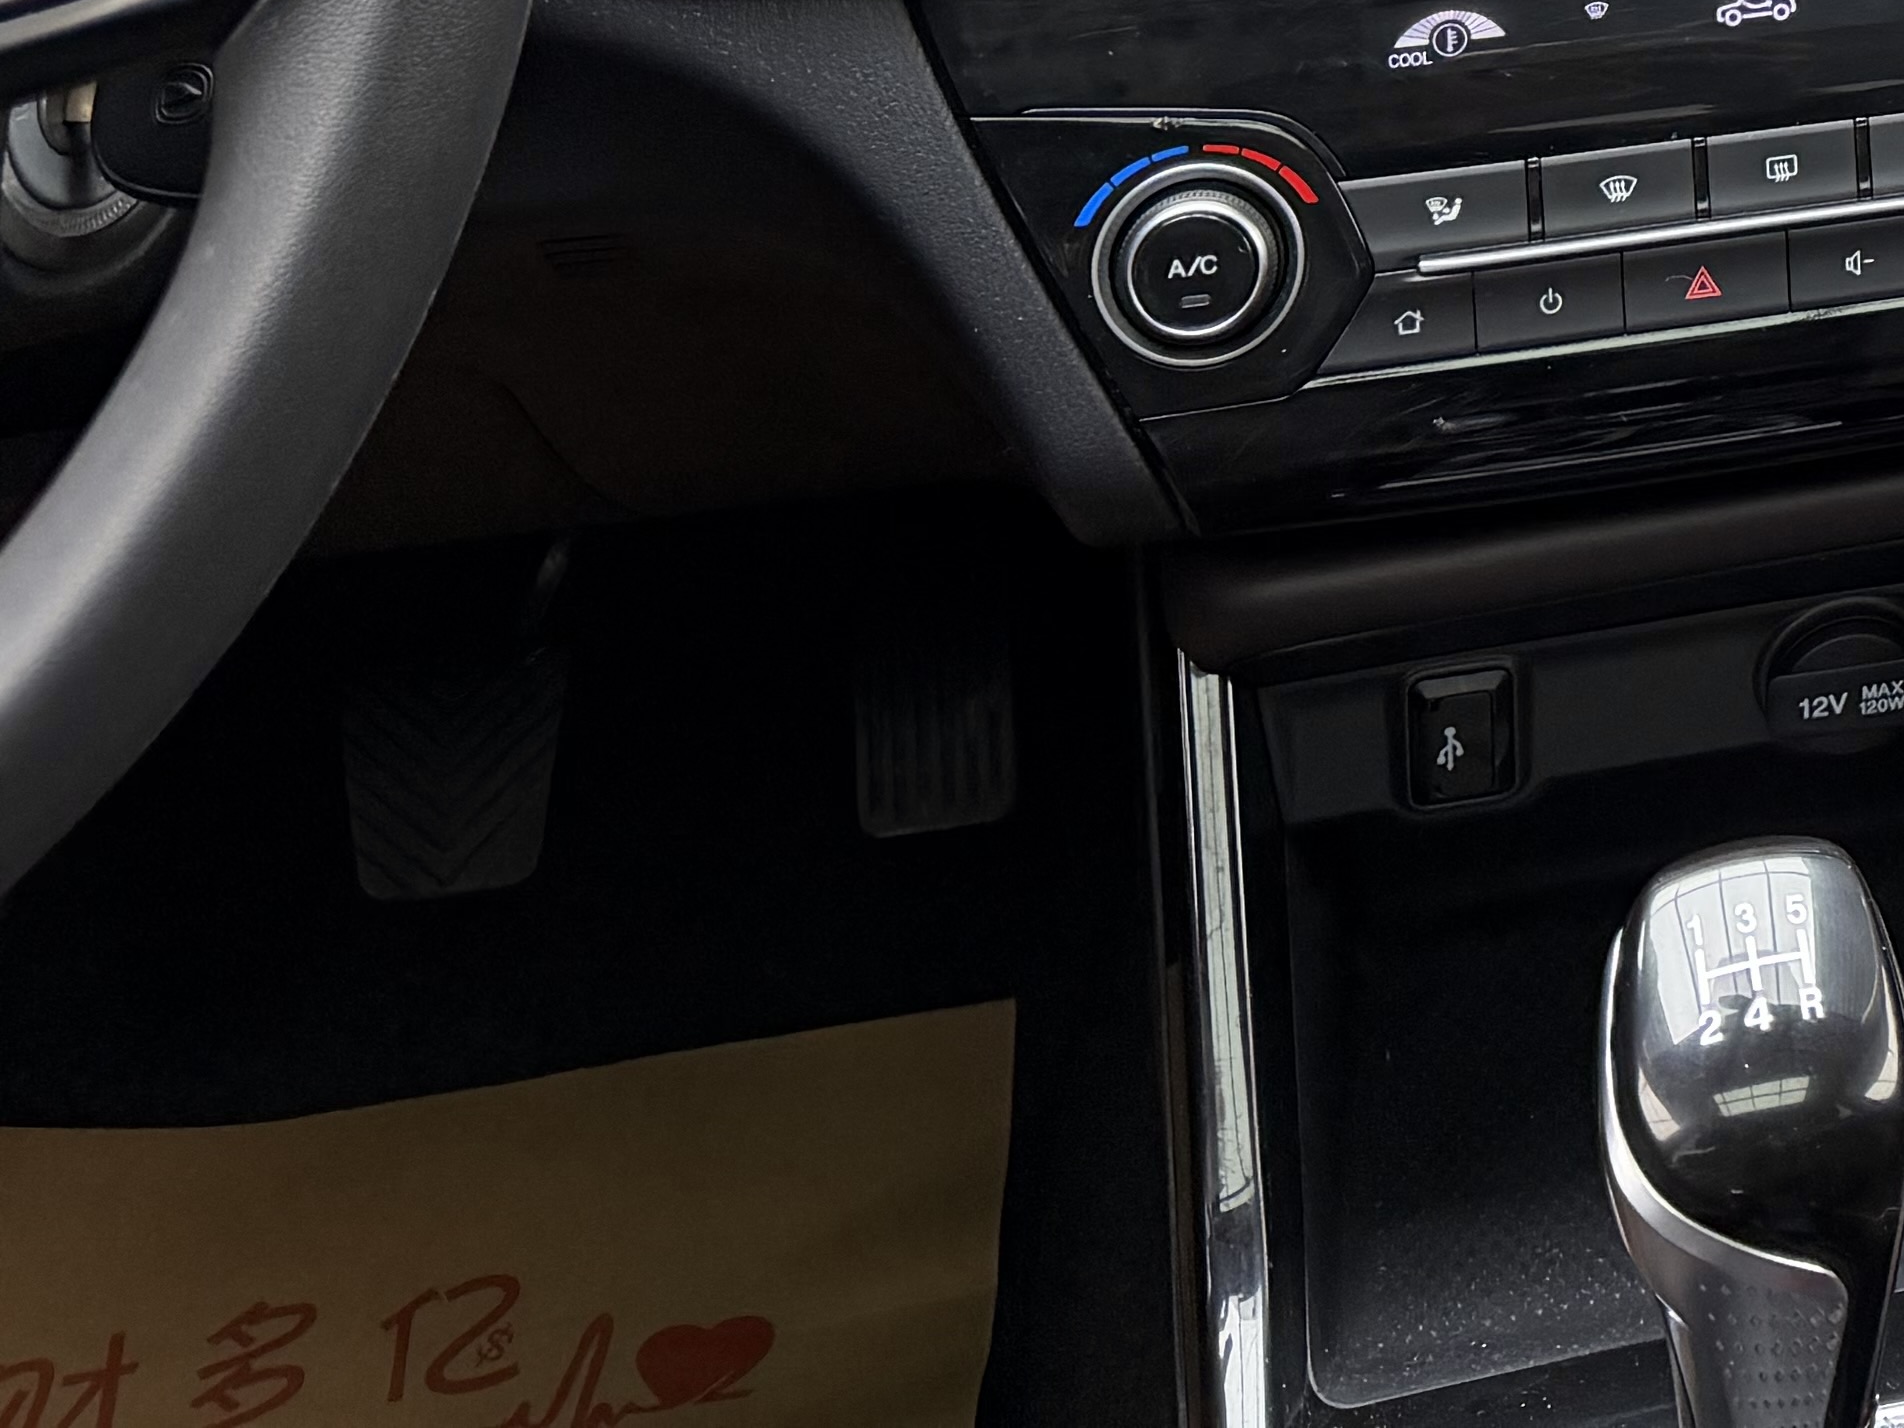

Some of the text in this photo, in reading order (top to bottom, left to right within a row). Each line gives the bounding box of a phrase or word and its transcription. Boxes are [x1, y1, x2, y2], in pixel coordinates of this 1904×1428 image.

[1388, 51, 1434, 69] COOL
[1167, 254, 1219, 280] A/C
[1861, 679, 1904, 700] MAX
[1799, 692, 1848, 719] 12V
[1686, 893, 1808, 946] 1 3 5
[1699, 986, 1826, 1046] 2 4 R
